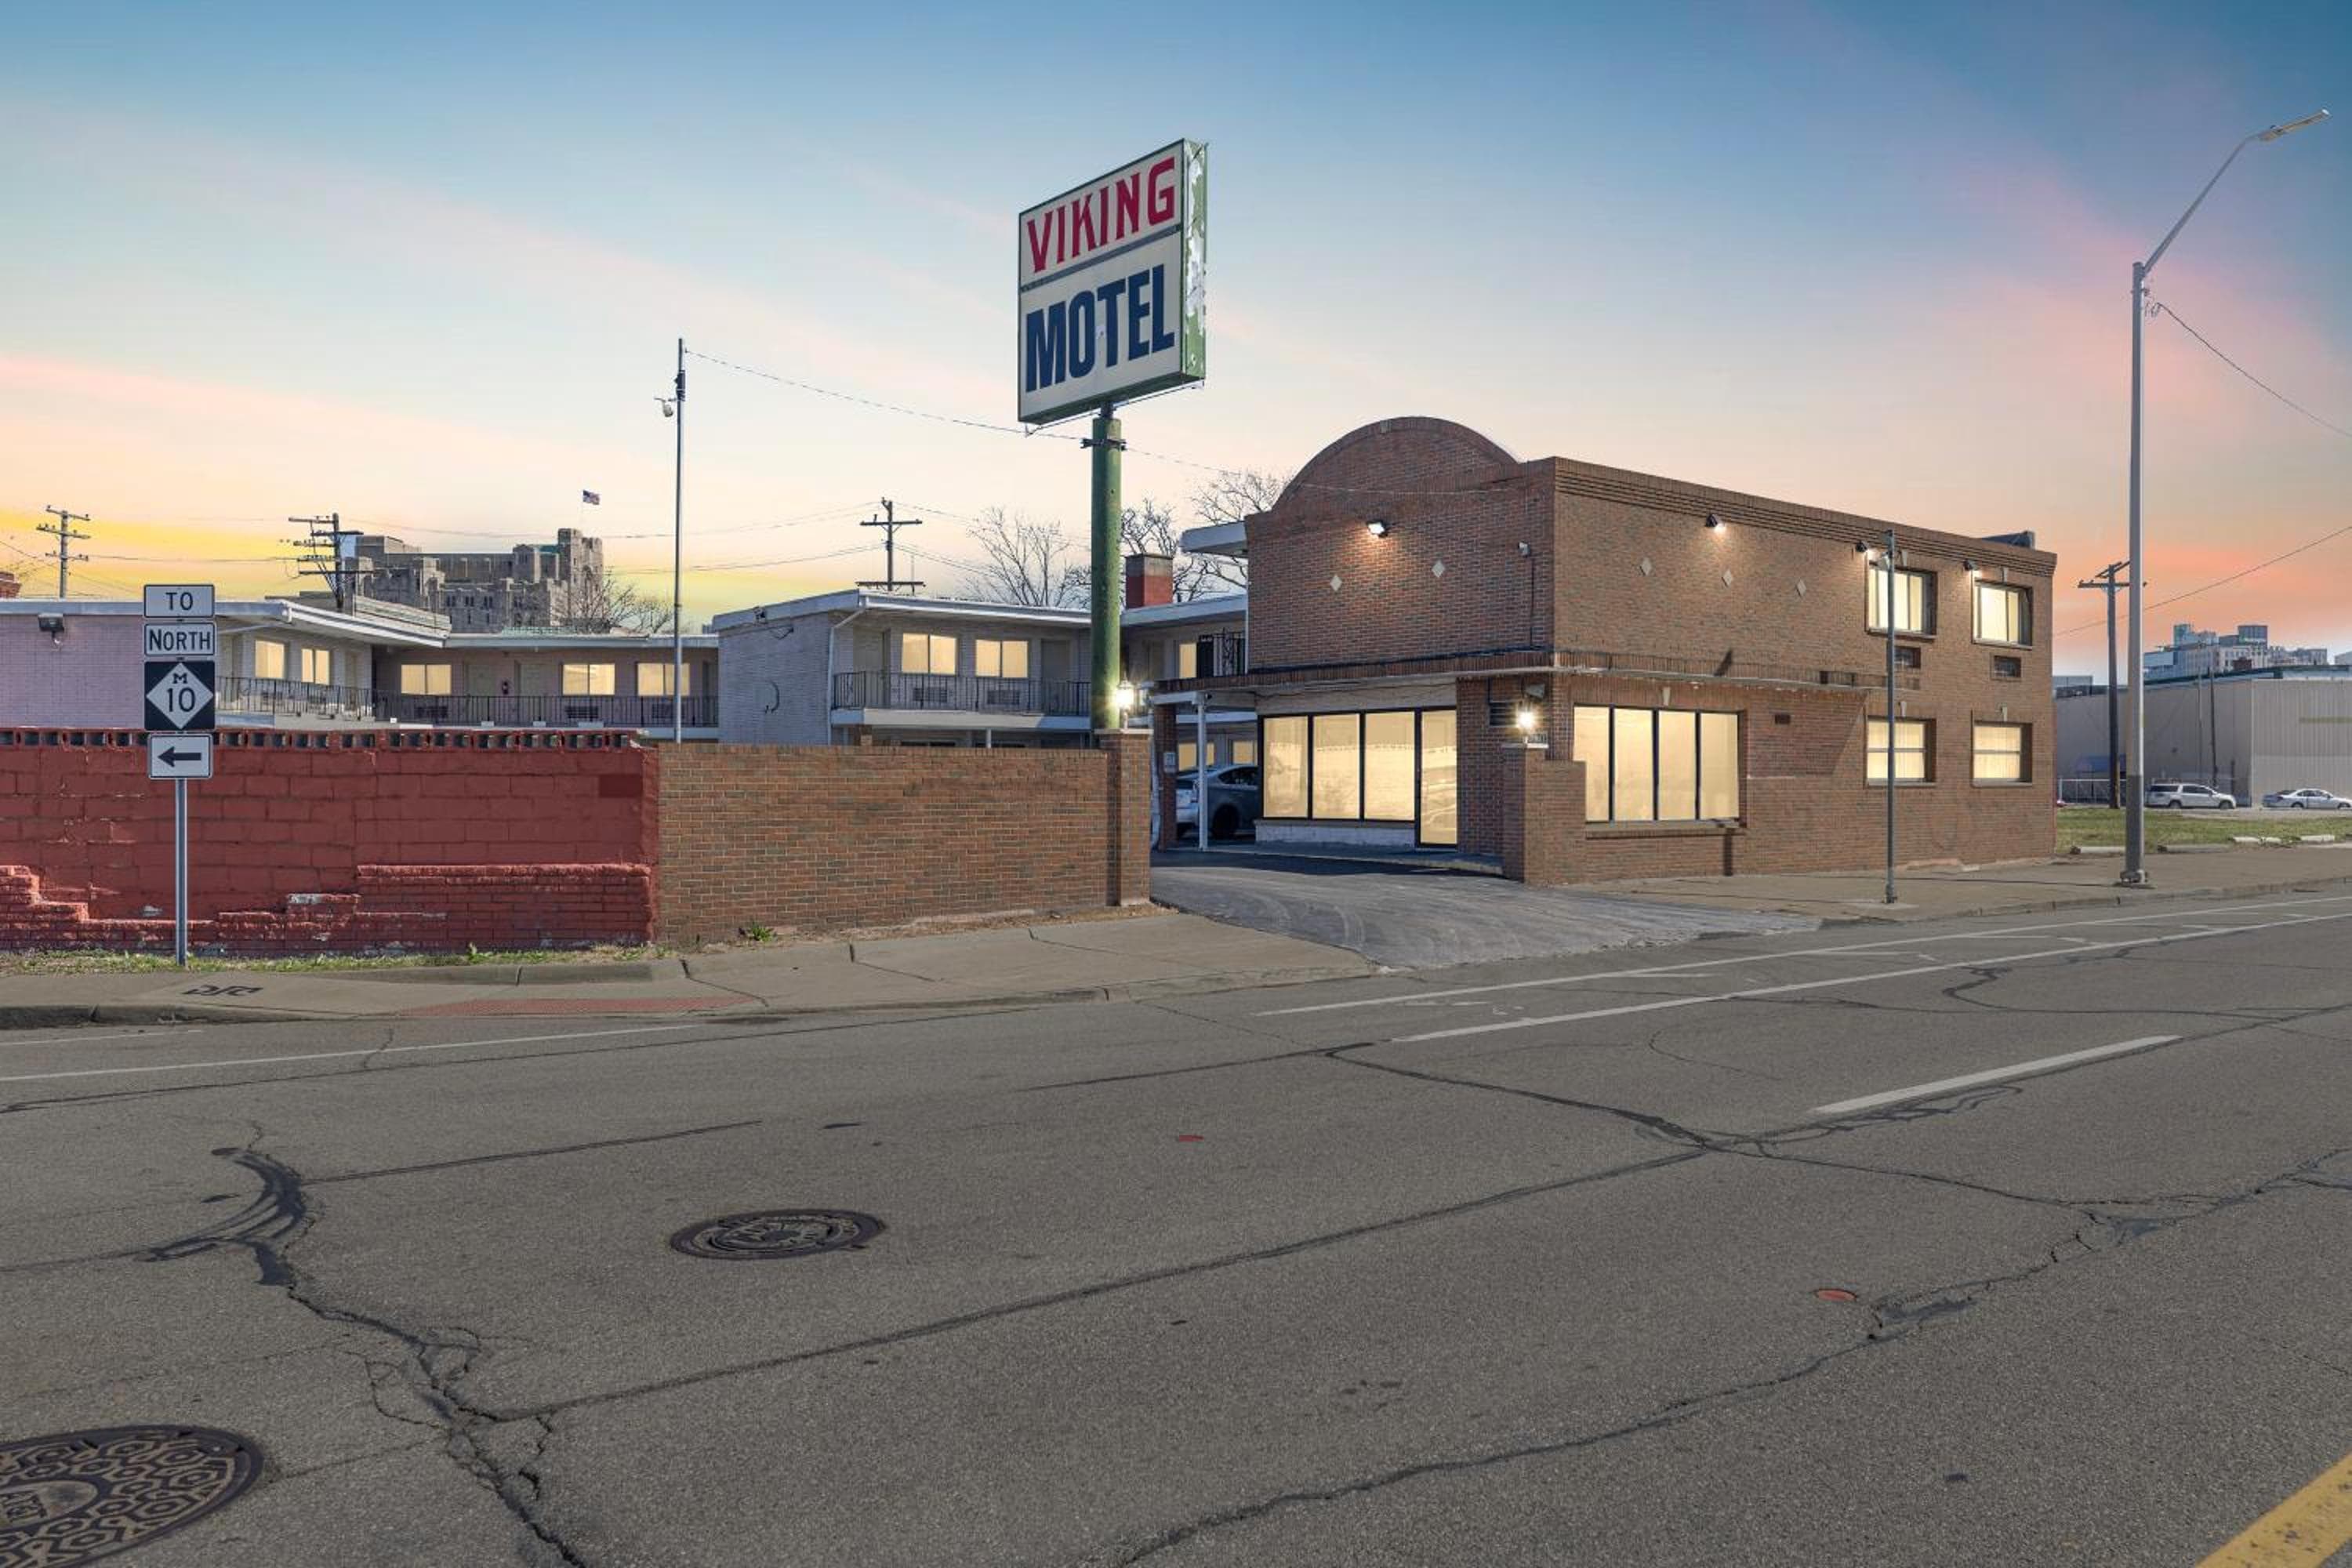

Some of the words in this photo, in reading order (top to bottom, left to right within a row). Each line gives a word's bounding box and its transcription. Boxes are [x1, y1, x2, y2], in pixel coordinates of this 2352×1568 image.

[1026, 156, 1175, 274] VIKING
[1025, 263, 1175, 393] MOTEL
[165, 592, 194, 611] TO
[149, 629, 211, 651] NORTH
[172, 673, 188, 684] M
[166, 687, 196, 713] 10
